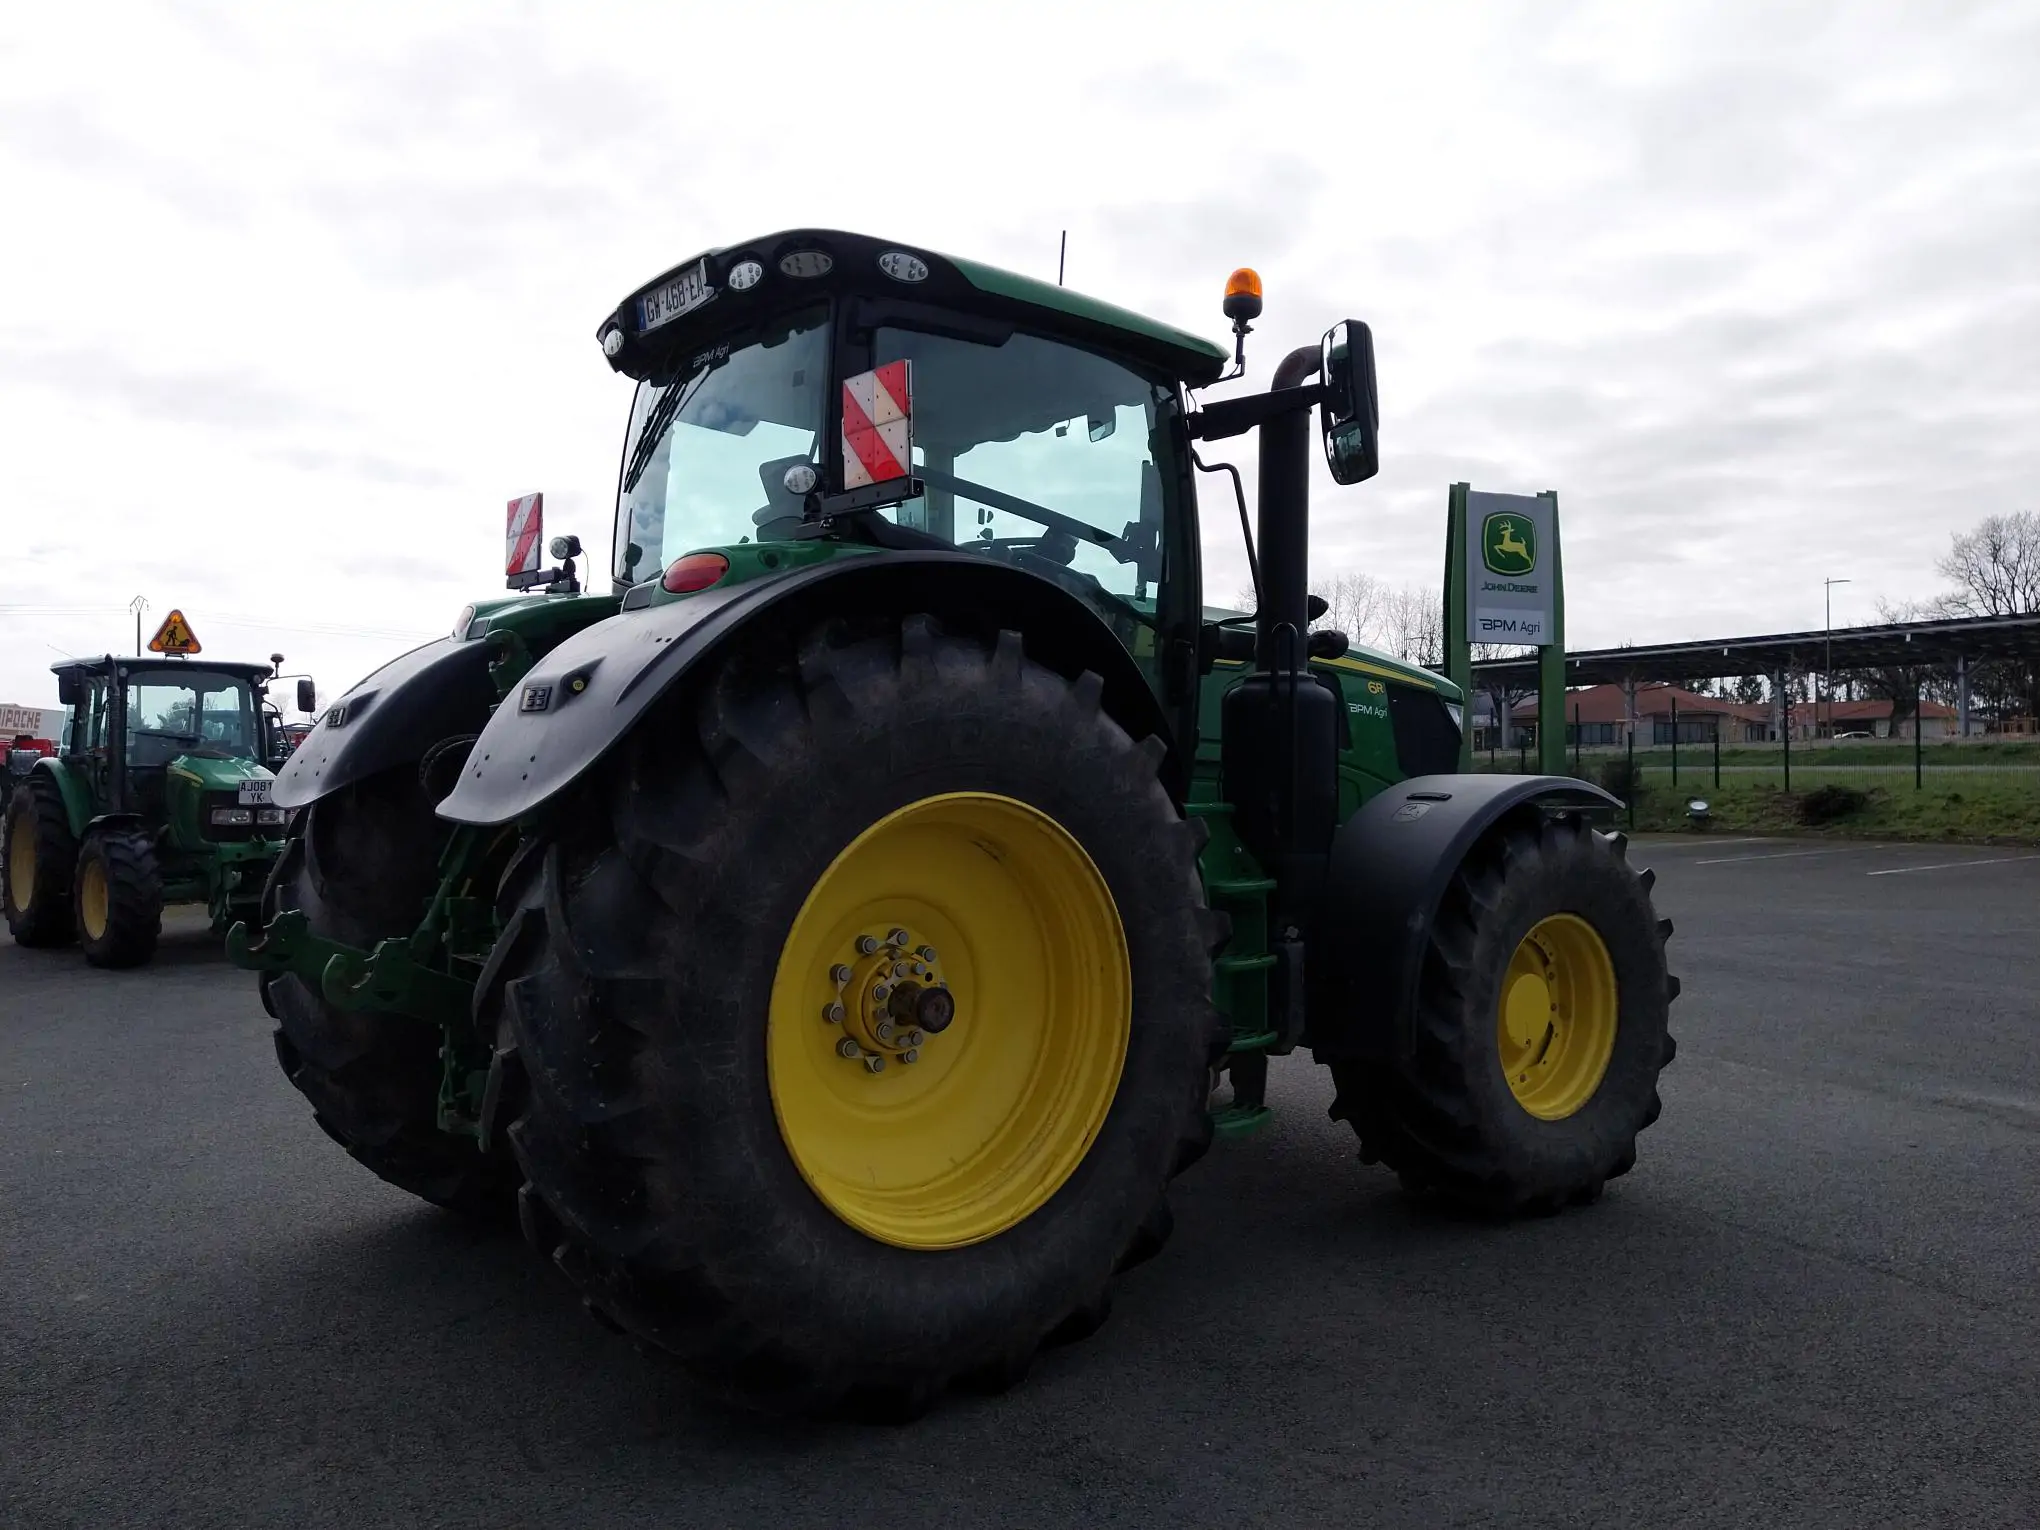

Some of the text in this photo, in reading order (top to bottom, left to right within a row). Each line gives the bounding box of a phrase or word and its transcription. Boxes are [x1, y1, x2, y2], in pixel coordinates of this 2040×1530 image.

[1481, 581, 1539, 593] JOHN DEERE
[1479, 618, 1541, 636] BPM Agri
[1367, 681, 1385, 695] 6R
[1348, 702, 1388, 719] BPM Agri
[250, 792, 264, 803] YK
